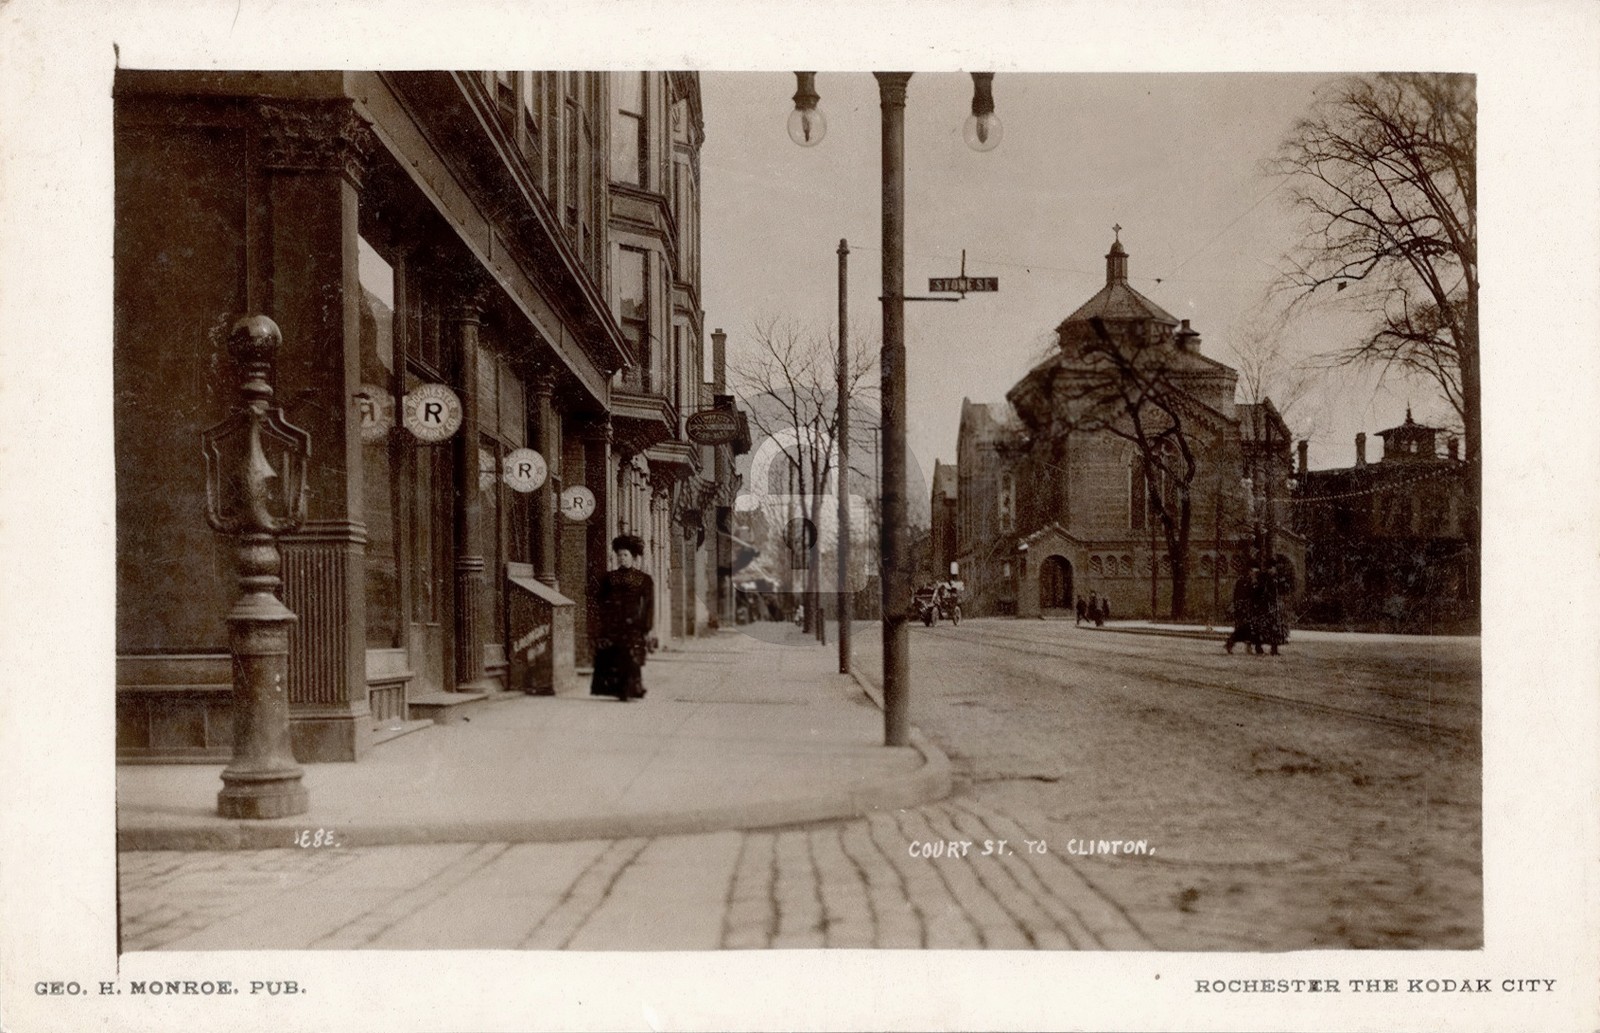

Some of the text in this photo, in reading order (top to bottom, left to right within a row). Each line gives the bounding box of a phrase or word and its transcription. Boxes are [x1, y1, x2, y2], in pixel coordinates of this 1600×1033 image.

[425, 403, 442, 423] R
[518, 462, 532, 479] R
[573, 496, 583, 509] R
